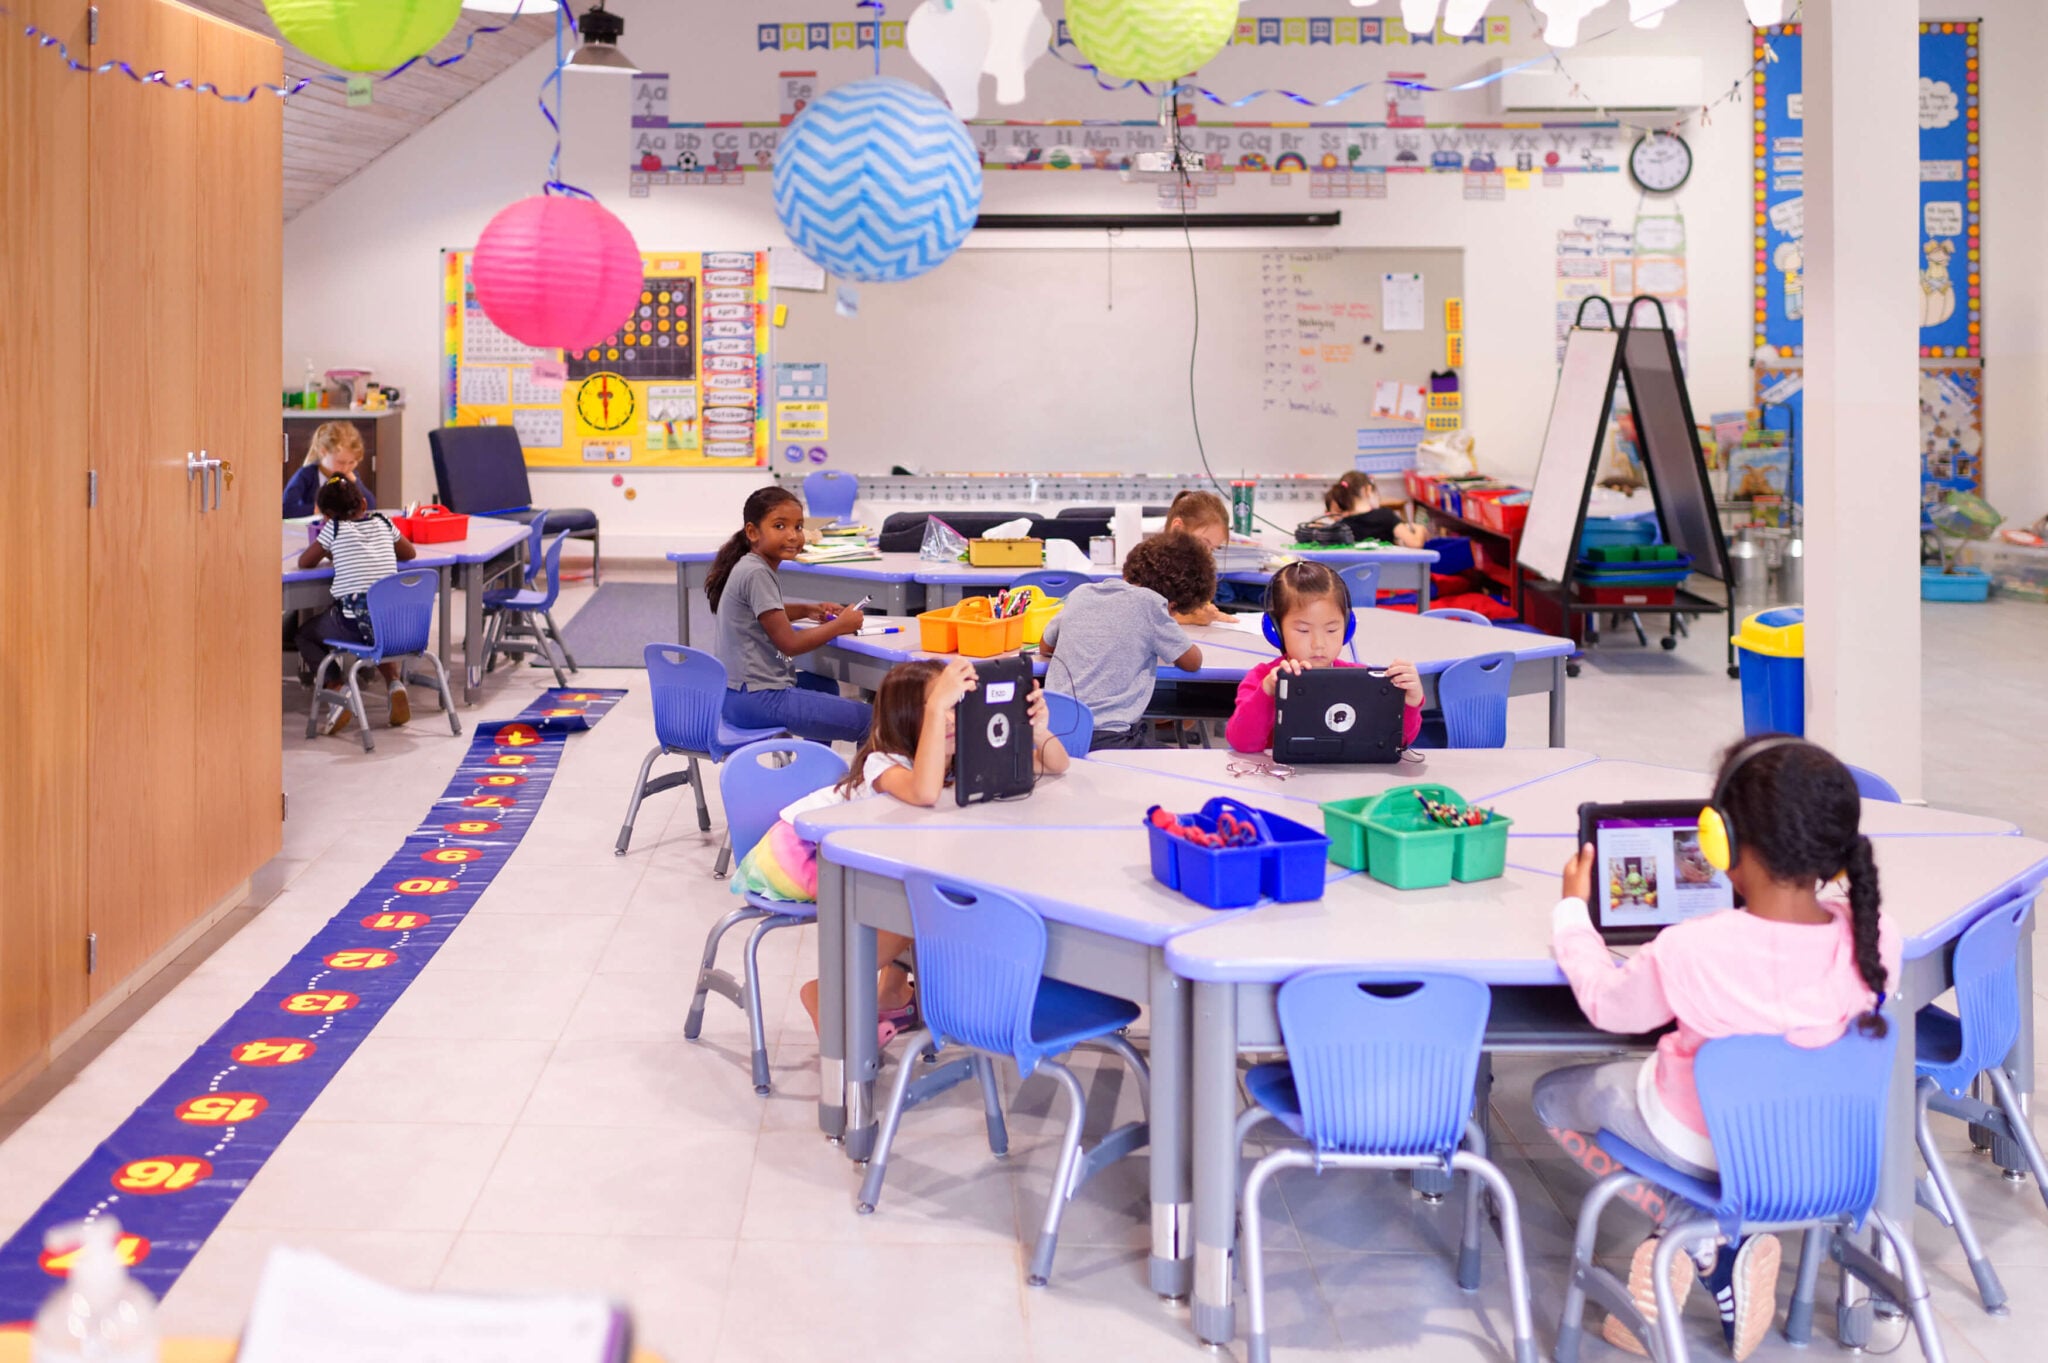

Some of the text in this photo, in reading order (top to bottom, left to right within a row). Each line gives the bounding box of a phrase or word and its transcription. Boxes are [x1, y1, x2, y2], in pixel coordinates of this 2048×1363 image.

[637, 83, 667, 100] Aa
[787, 81, 812, 98] Ee
[636, 133, 666, 149] Aa
[675, 133, 701, 149] Bb
[712, 132, 739, 149] Cc
[749, 132, 777, 149] Dd
[982, 130, 997, 150] Jj
[1013, 130, 1040, 147] Kk
[1084, 131, 1120, 147] Mm
[1126, 131, 1155, 147] Nn
[1206, 132, 1230, 152] Pp
[1238, 132, 1271, 152] Qq
[1280, 132, 1304, 149] Rr
[1321, 132, 1341, 148] Ss
[1359, 132, 1379, 148] Tt
[1432, 133, 1462, 149] Vv
[1510, 132, 1540, 149] Xx
[1550, 132, 1577, 153] Yy
[1590, 132, 1614, 149] Zz
[710, 255, 745, 266] January
[717, 306, 738, 316] April
[719, 325, 738, 335] May
[717, 341, 739, 349] June
[719, 359, 738, 369] July
[473, 798, 501, 807] 7
[458, 823, 489, 833] 8
[436, 850, 469, 861] 9
[398, 880, 451, 893] 10
[373, 914, 417, 929] 11
[329, 952, 388, 969] 12
[287, 994, 349, 1011] 13
[238, 1042, 307, 1063] 14
[181, 1097, 258, 1121] 15
[119, 1161, 201, 1189] 16
